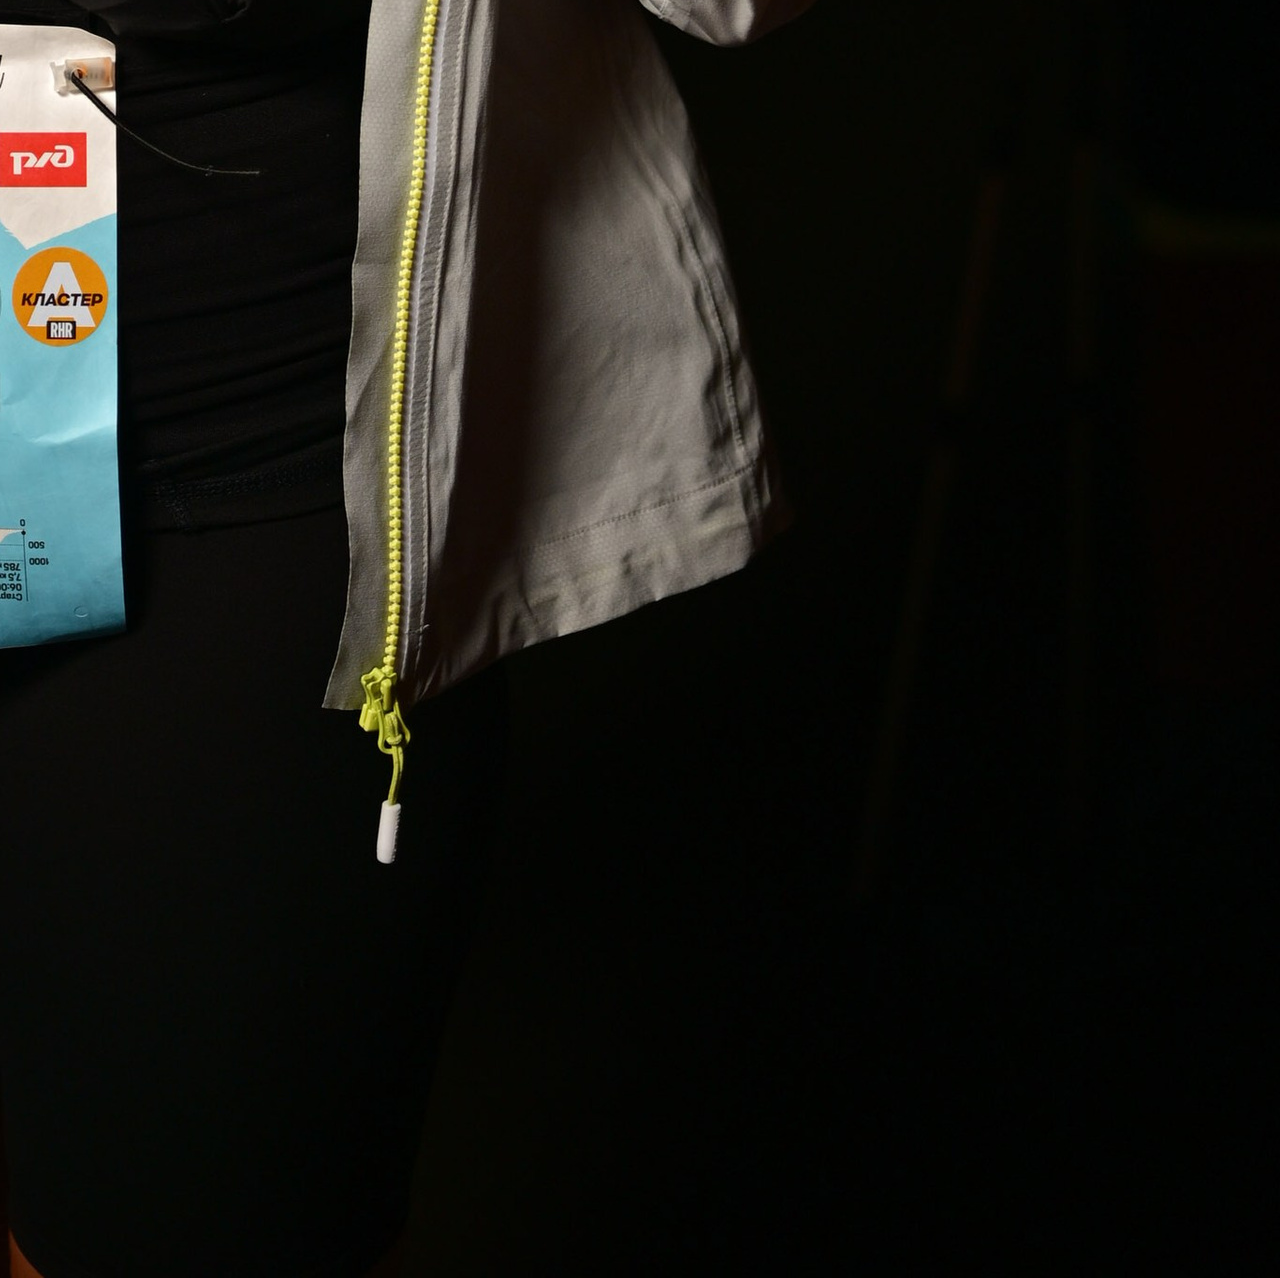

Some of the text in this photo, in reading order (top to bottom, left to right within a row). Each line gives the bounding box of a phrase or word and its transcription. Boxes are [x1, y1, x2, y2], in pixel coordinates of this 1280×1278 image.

[21, 292, 103, 307] КЛАСТЕР
[50, 322, 73, 338] RHR
[20, 519, 26, 527] 0
[28, 541, 45, 549] 500
[29, 557, 49, 566] 1000
[3, 562, 22, 571] 785
[8, 572, 22, 581] 7,5
